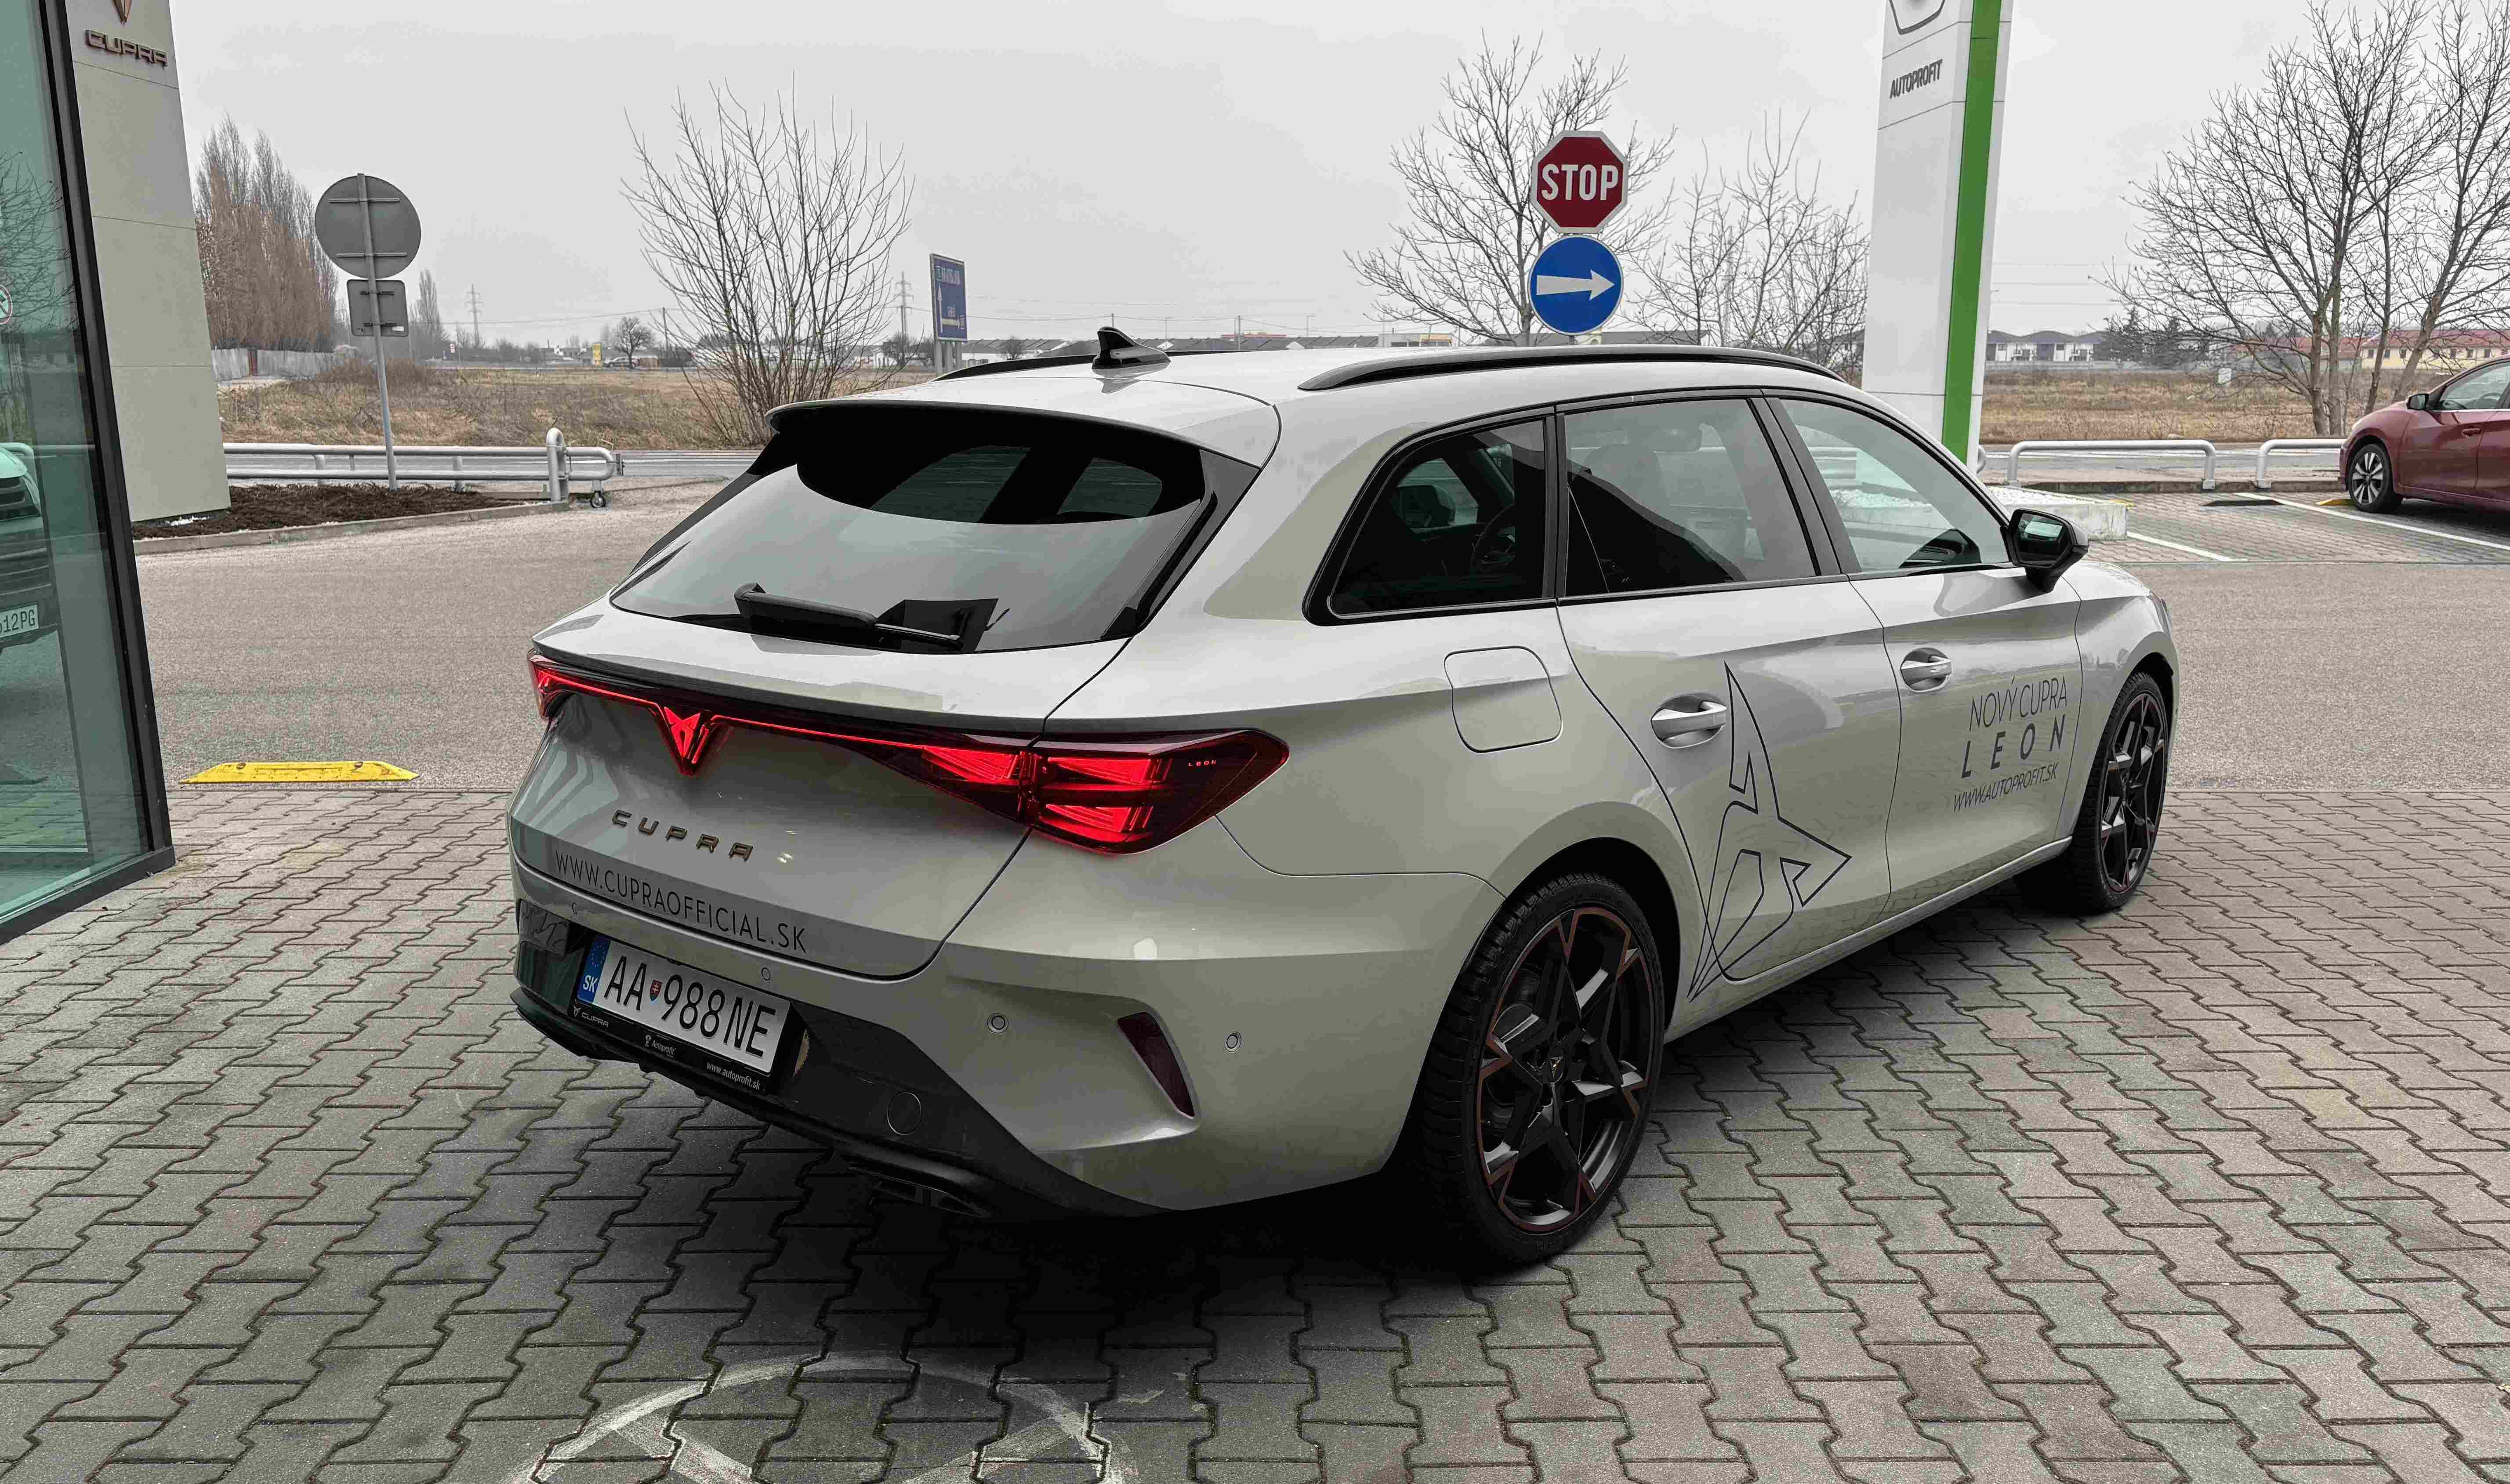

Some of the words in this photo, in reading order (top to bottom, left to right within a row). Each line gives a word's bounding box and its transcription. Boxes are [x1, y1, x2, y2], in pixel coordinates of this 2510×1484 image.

[85, 29, 168, 67] CUPRA
[1890, 58, 1943, 99] AUTOPROFIT
[1541, 163, 1618, 201] STOP
[0, 609, 35, 633] 12PG
[1970, 675, 2017, 732] NOVÝ
[2020, 675, 2067, 718] CUPRA
[1962, 714, 2066, 778] LEON
[1954, 763, 2059, 812] WWW.AUTOPROFIT.SK
[612, 809, 753, 861] CUPRA
[555, 850, 806, 953] WWW.CUPRAOFFICIAL.SK
[583, 975, 598, 993] SK
[581, 1012, 609, 1028] CUPRA
[707, 1062, 760, 1090] www.autoprofit.sk
